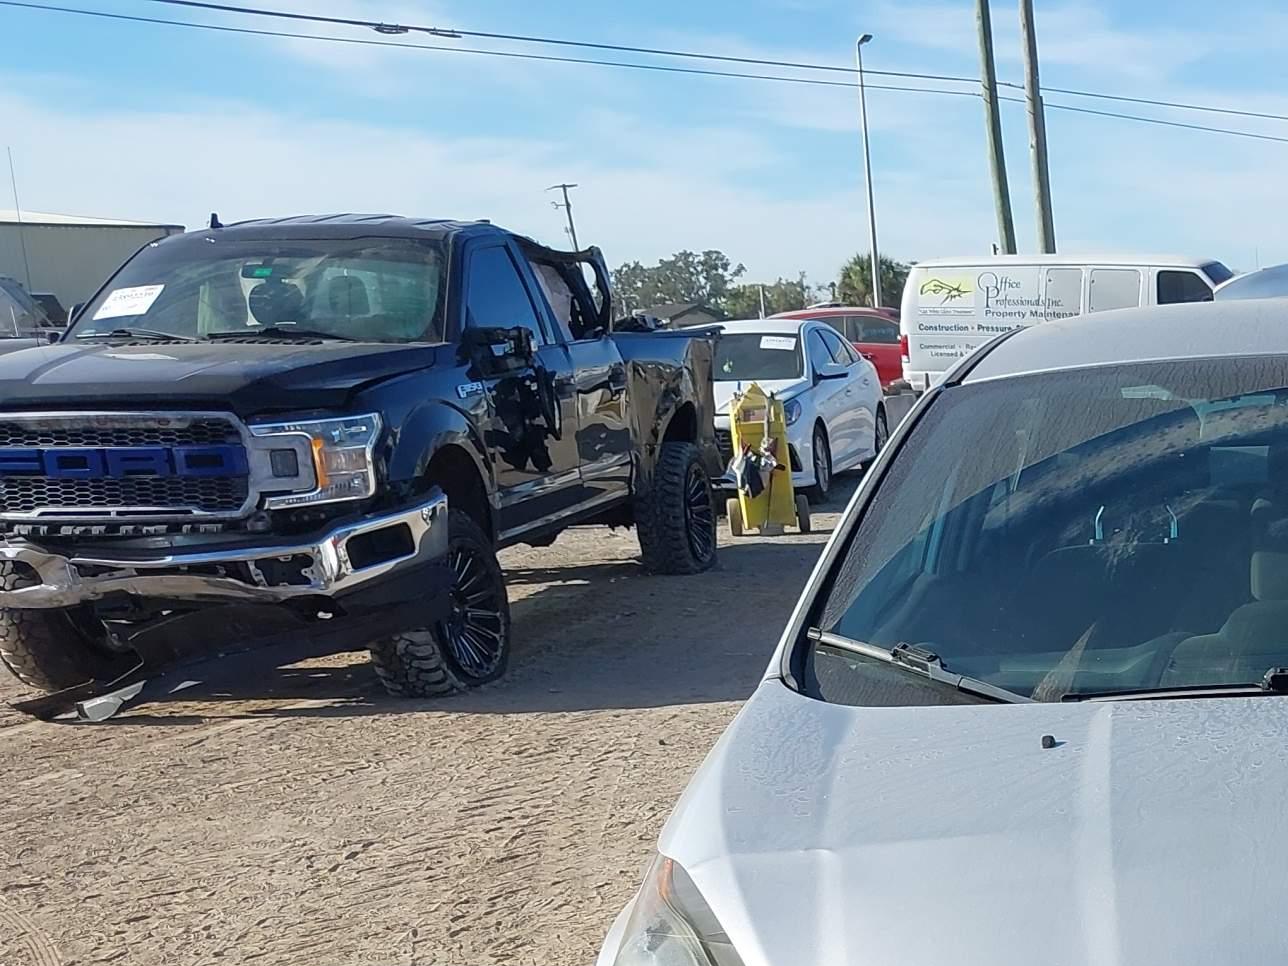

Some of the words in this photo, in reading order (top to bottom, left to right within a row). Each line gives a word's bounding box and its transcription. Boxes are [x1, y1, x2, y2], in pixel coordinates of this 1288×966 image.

[977, 271, 1021, 293] Office
[985, 286, 1046, 309] Professionals
[1047, 297, 1064, 309] Inc.
[985, 310, 1026, 319] Property
[918, 323, 969, 332] Construction
[930, 350, 959, 358] Licensed
